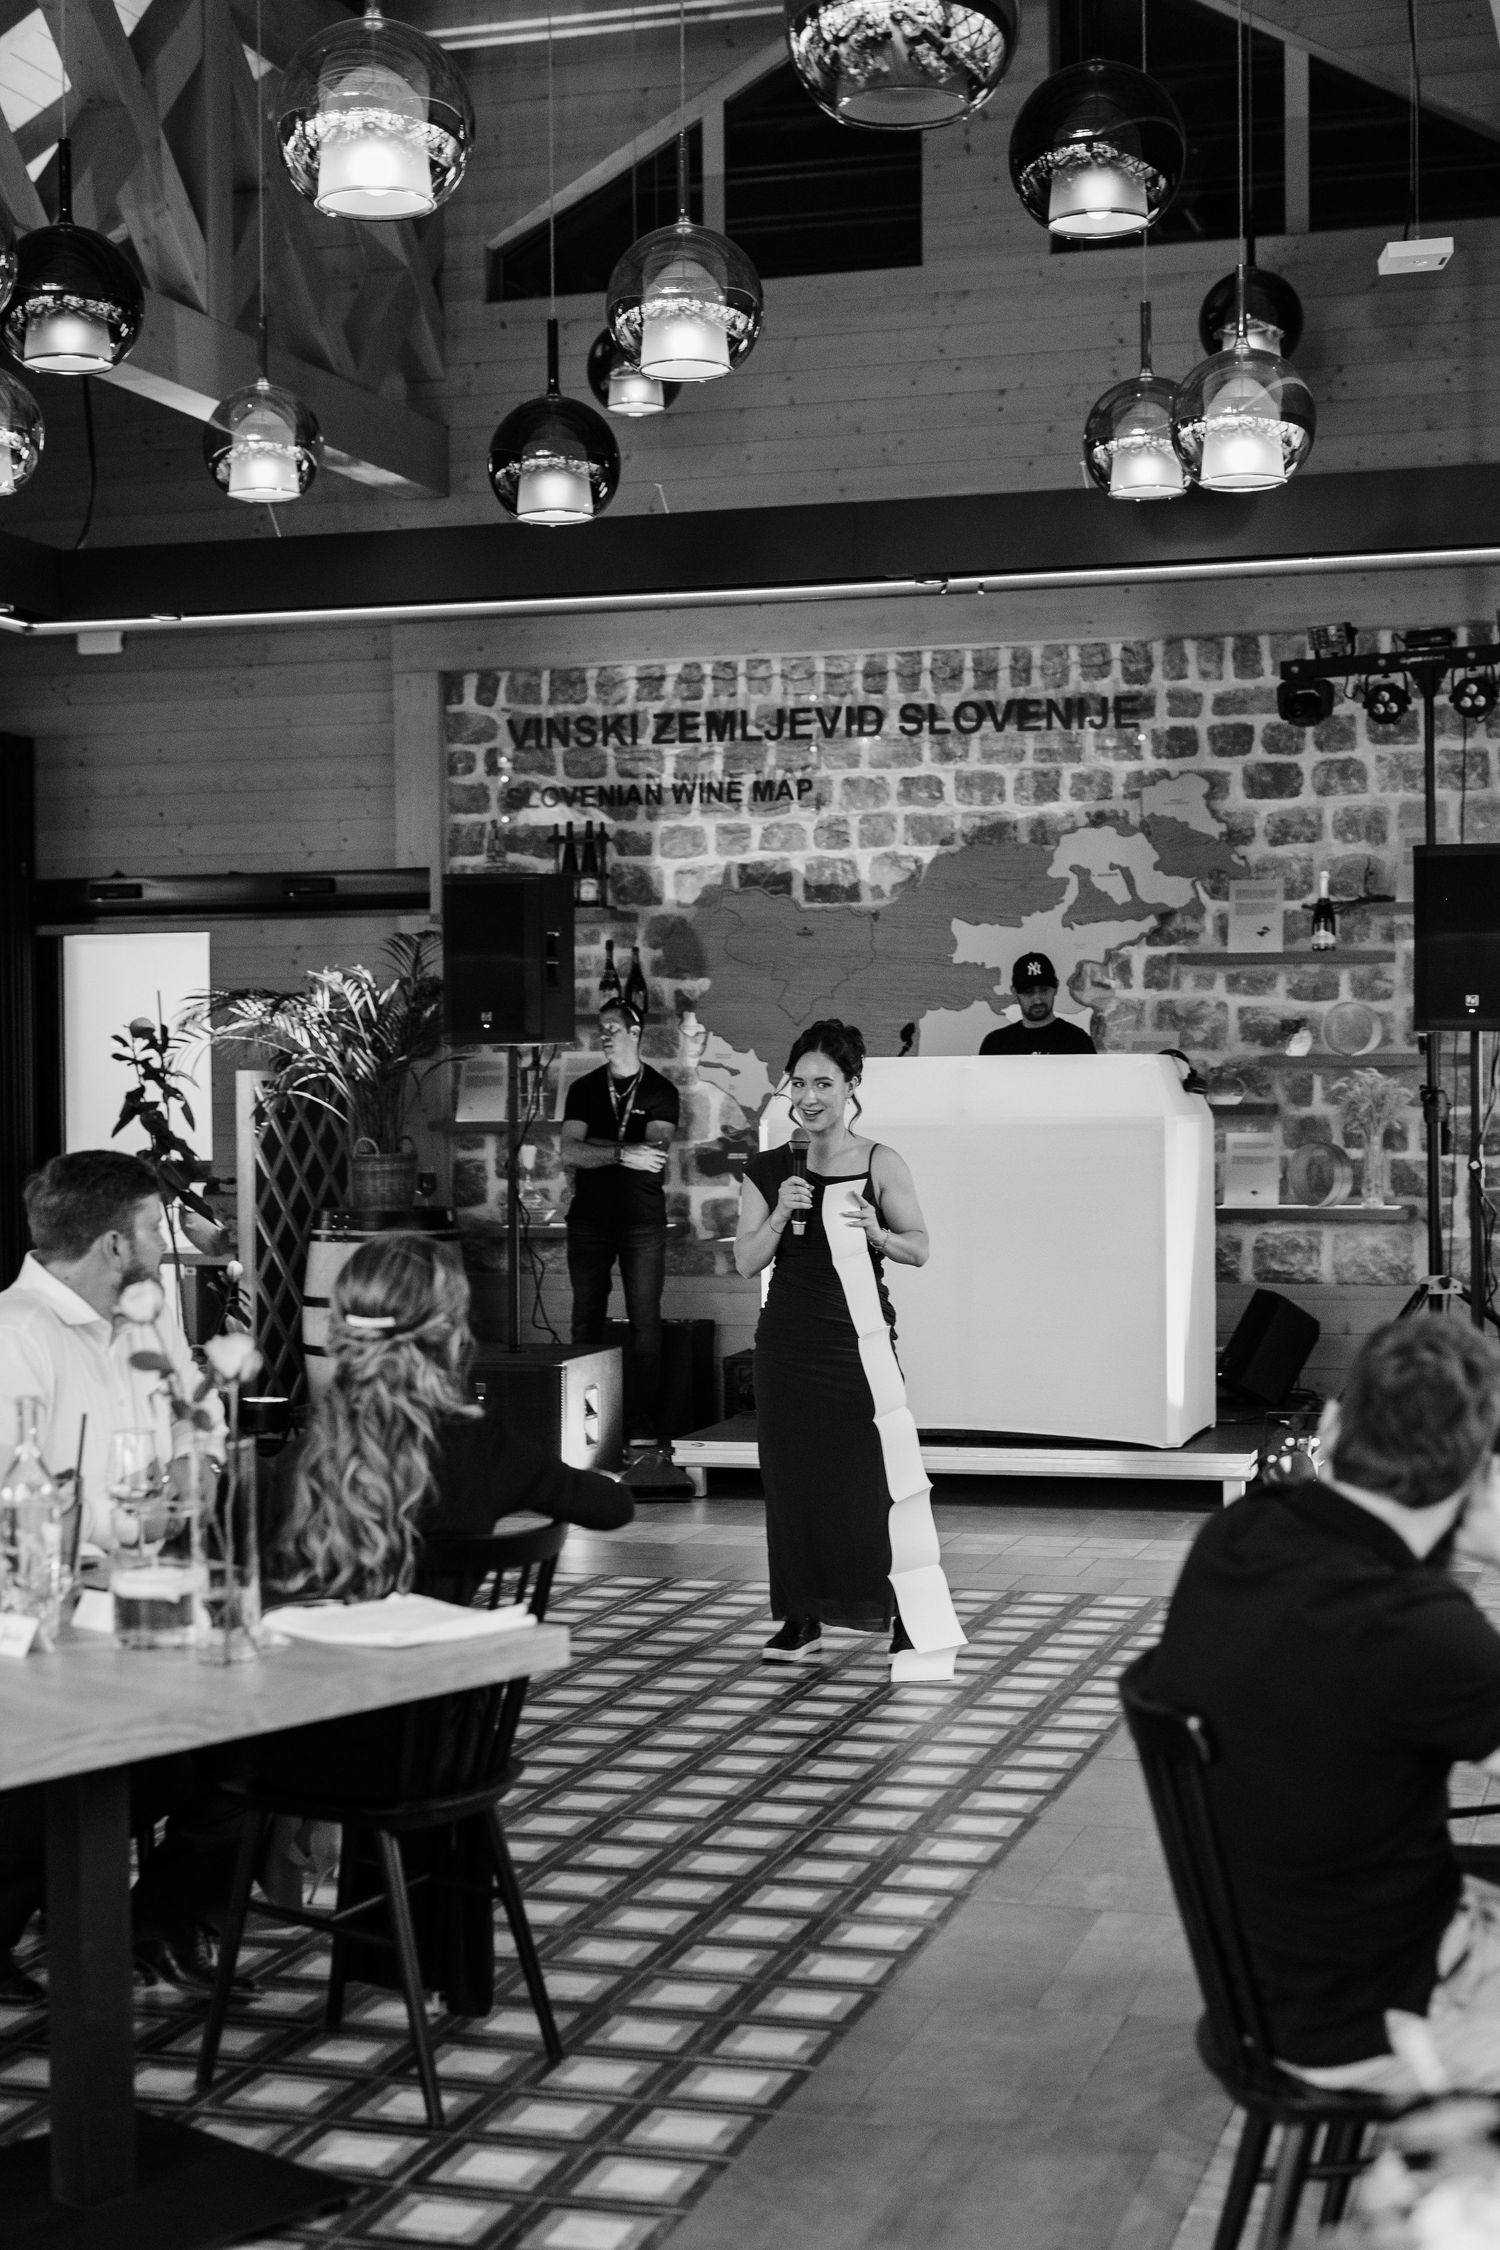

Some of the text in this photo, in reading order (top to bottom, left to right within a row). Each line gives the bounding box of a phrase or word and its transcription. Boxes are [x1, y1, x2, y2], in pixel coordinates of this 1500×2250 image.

[507, 695, 1140, 749] VINSKI ZEMLJEVID SLOVENIJE
[507, 779, 813, 808] SLOVENIAN WINE MAP
[1027, 961, 1042, 975] NY
